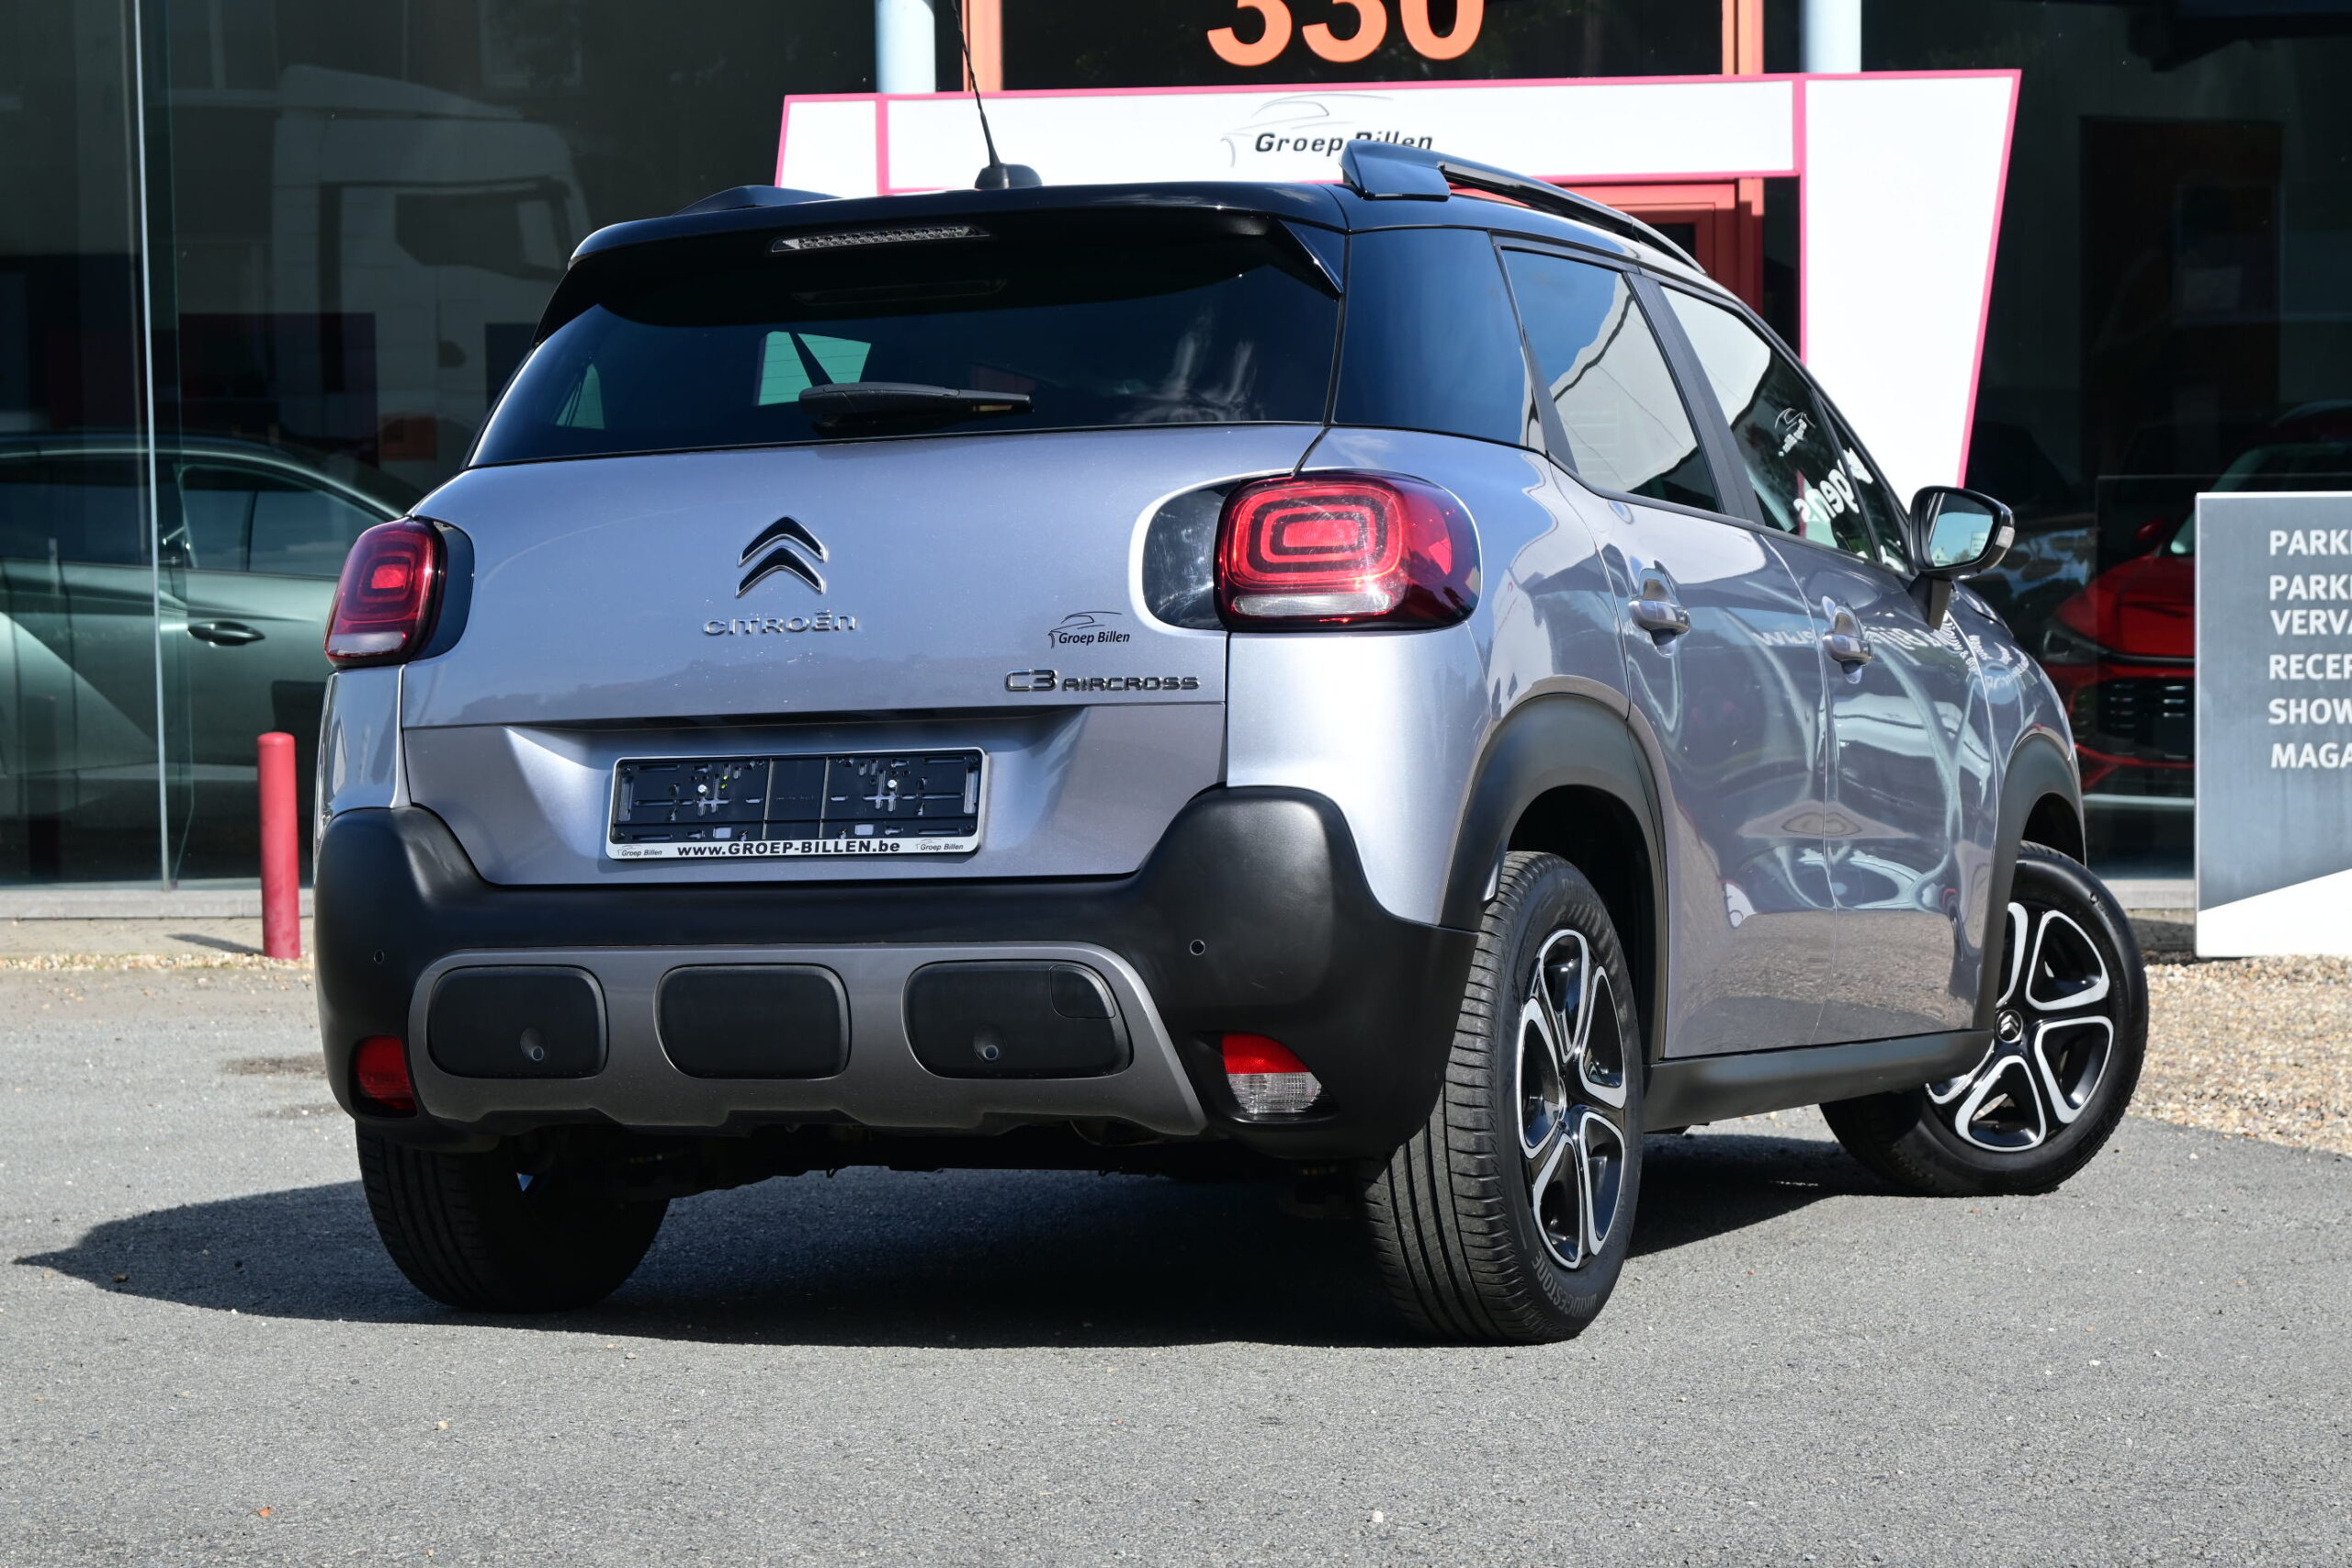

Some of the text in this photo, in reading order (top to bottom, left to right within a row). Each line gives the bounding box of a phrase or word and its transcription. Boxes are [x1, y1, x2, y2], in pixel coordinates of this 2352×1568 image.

[1255, 132, 1344, 156] Groep
[2270, 609, 2352, 637] VERV
[1058, 631, 1130, 646] Groep Billen
[1005, 670, 1199, 691] C3 AIRCROSS
[677, 840, 900, 856] www.GROEP-BILLEN.be
